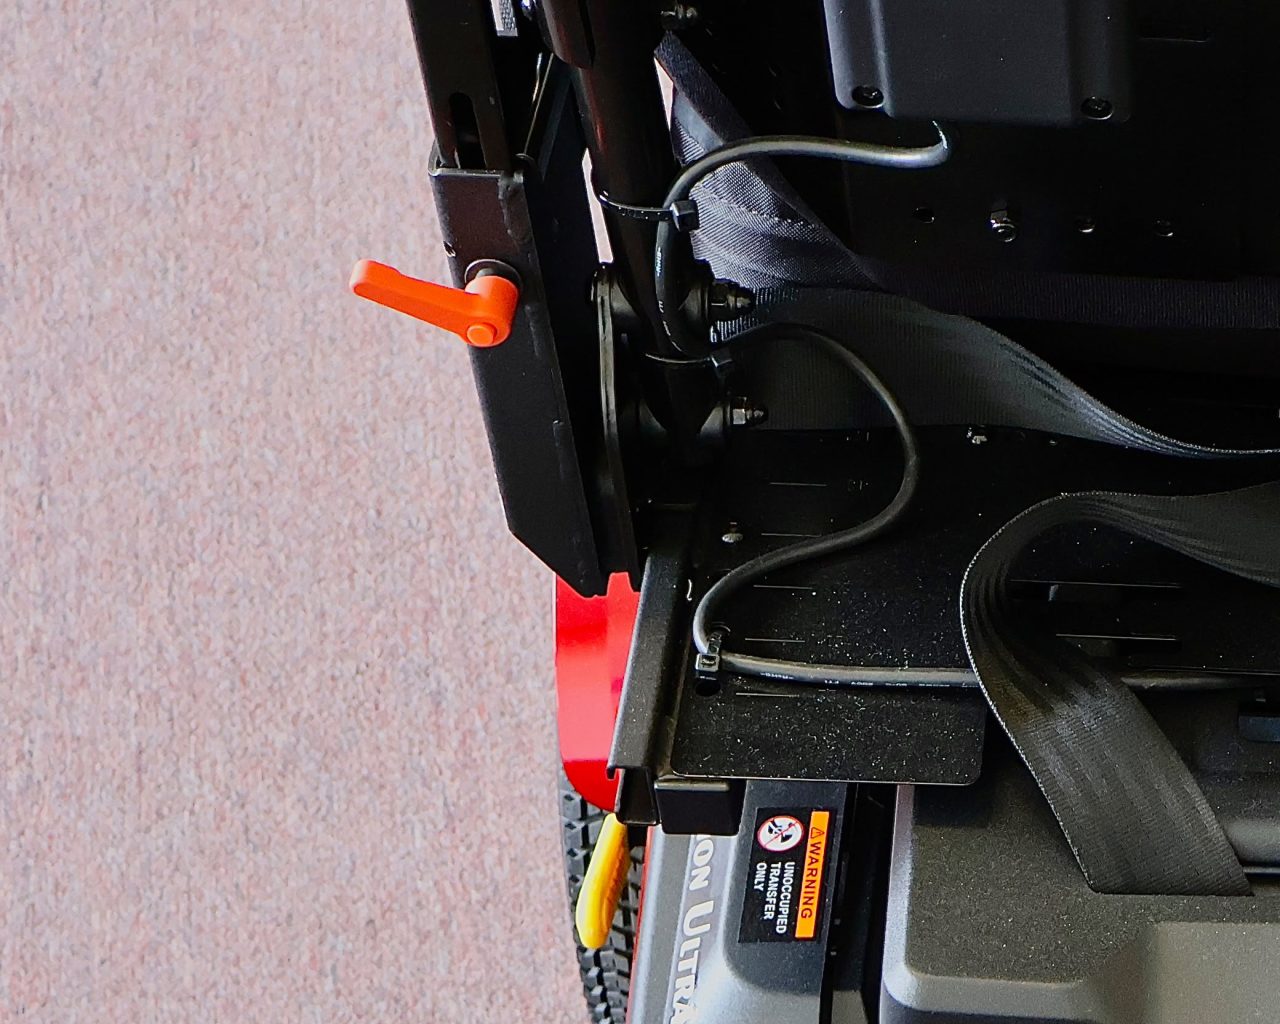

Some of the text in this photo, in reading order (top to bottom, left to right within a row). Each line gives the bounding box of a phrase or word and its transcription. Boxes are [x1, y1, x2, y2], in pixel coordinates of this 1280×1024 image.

[753, 861, 768, 892] ONLY
[762, 860, 783, 921] TRANSFER
[775, 860, 796, 935] UNOCCUPIED
[799, 841, 825, 920] WARNING
